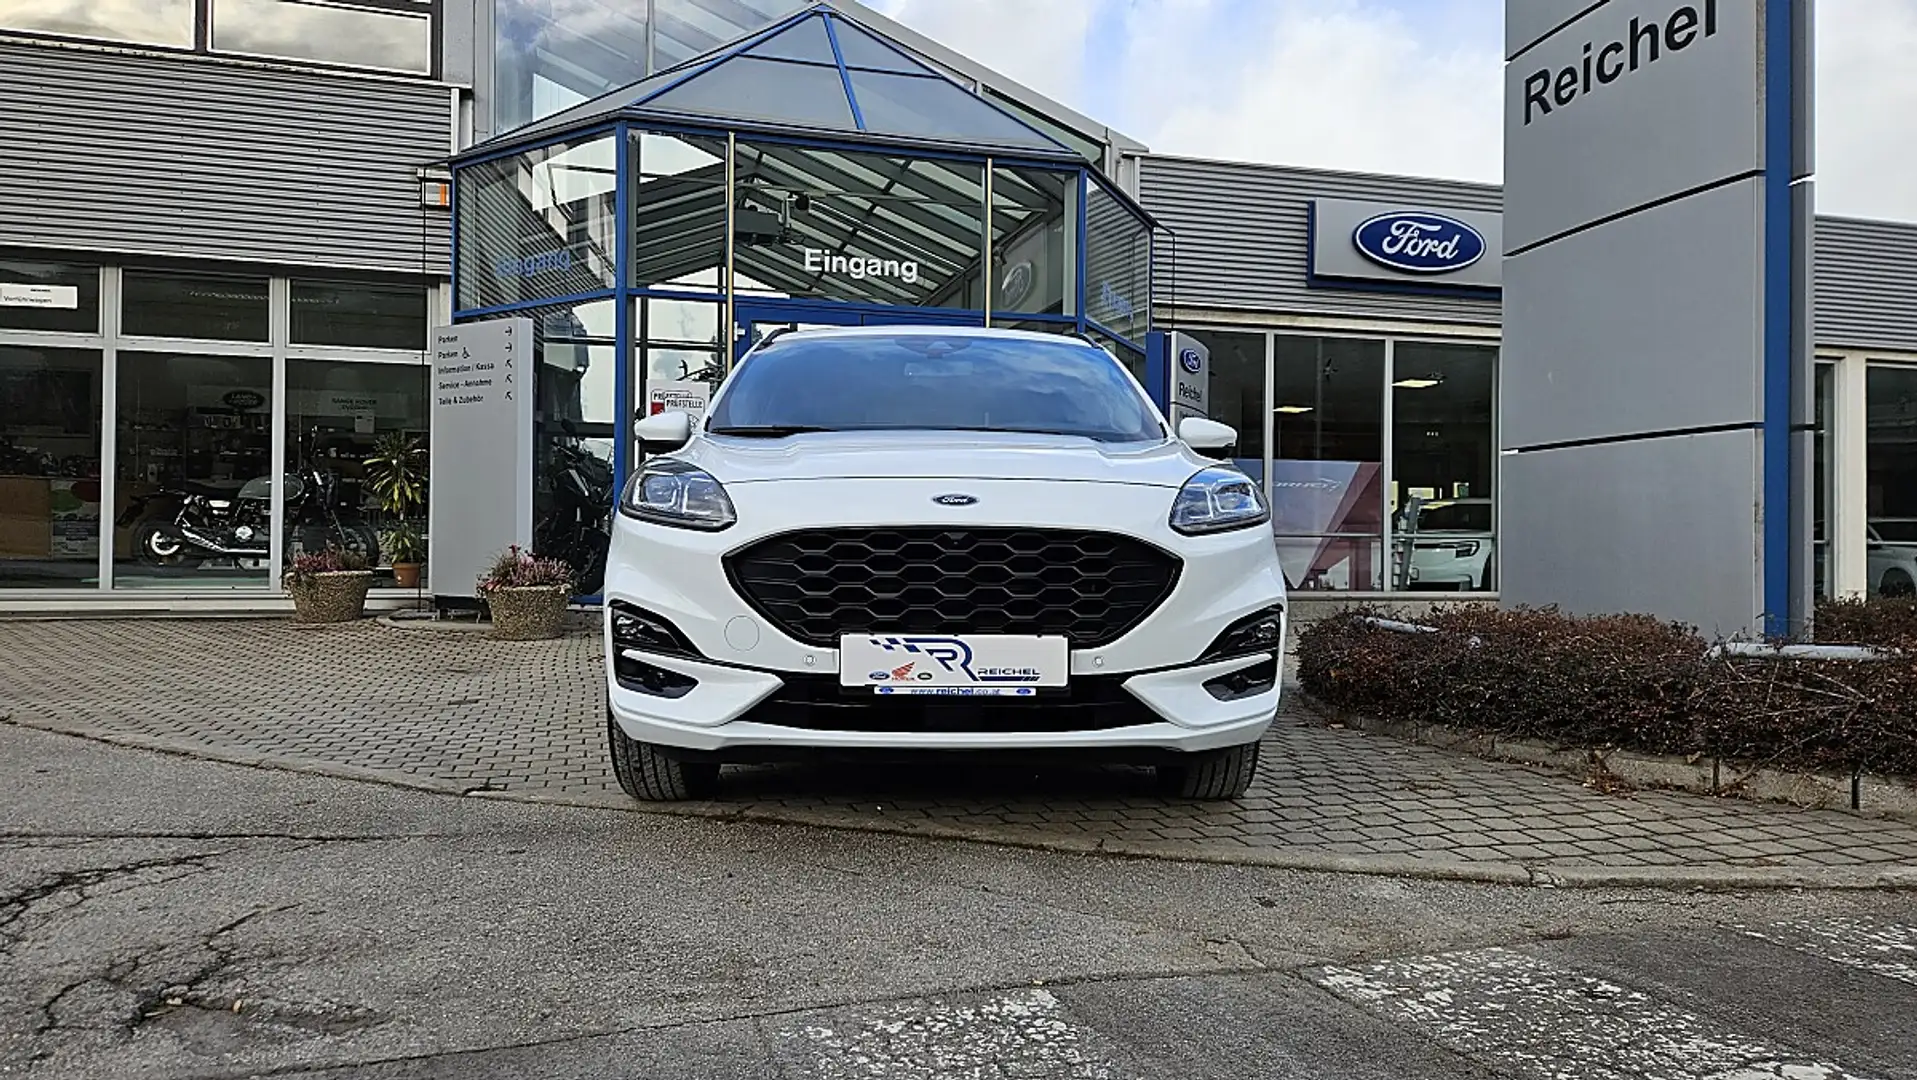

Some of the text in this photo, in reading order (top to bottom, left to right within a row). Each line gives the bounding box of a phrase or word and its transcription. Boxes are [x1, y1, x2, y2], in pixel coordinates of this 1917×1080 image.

[1524, 0, 1716, 125] Reichel
[1382, 221, 1460, 259] Ford
[805, 248, 918, 284] Eingang
[438, 335, 458, 344] Parken
[438, 351, 458, 359] Parken
[438, 364, 471, 375] Information
[439, 381, 460, 390] Service
[977, 667, 1041, 675] REICHEL
[910, 687, 1001, 695] www.reichel.co.at
